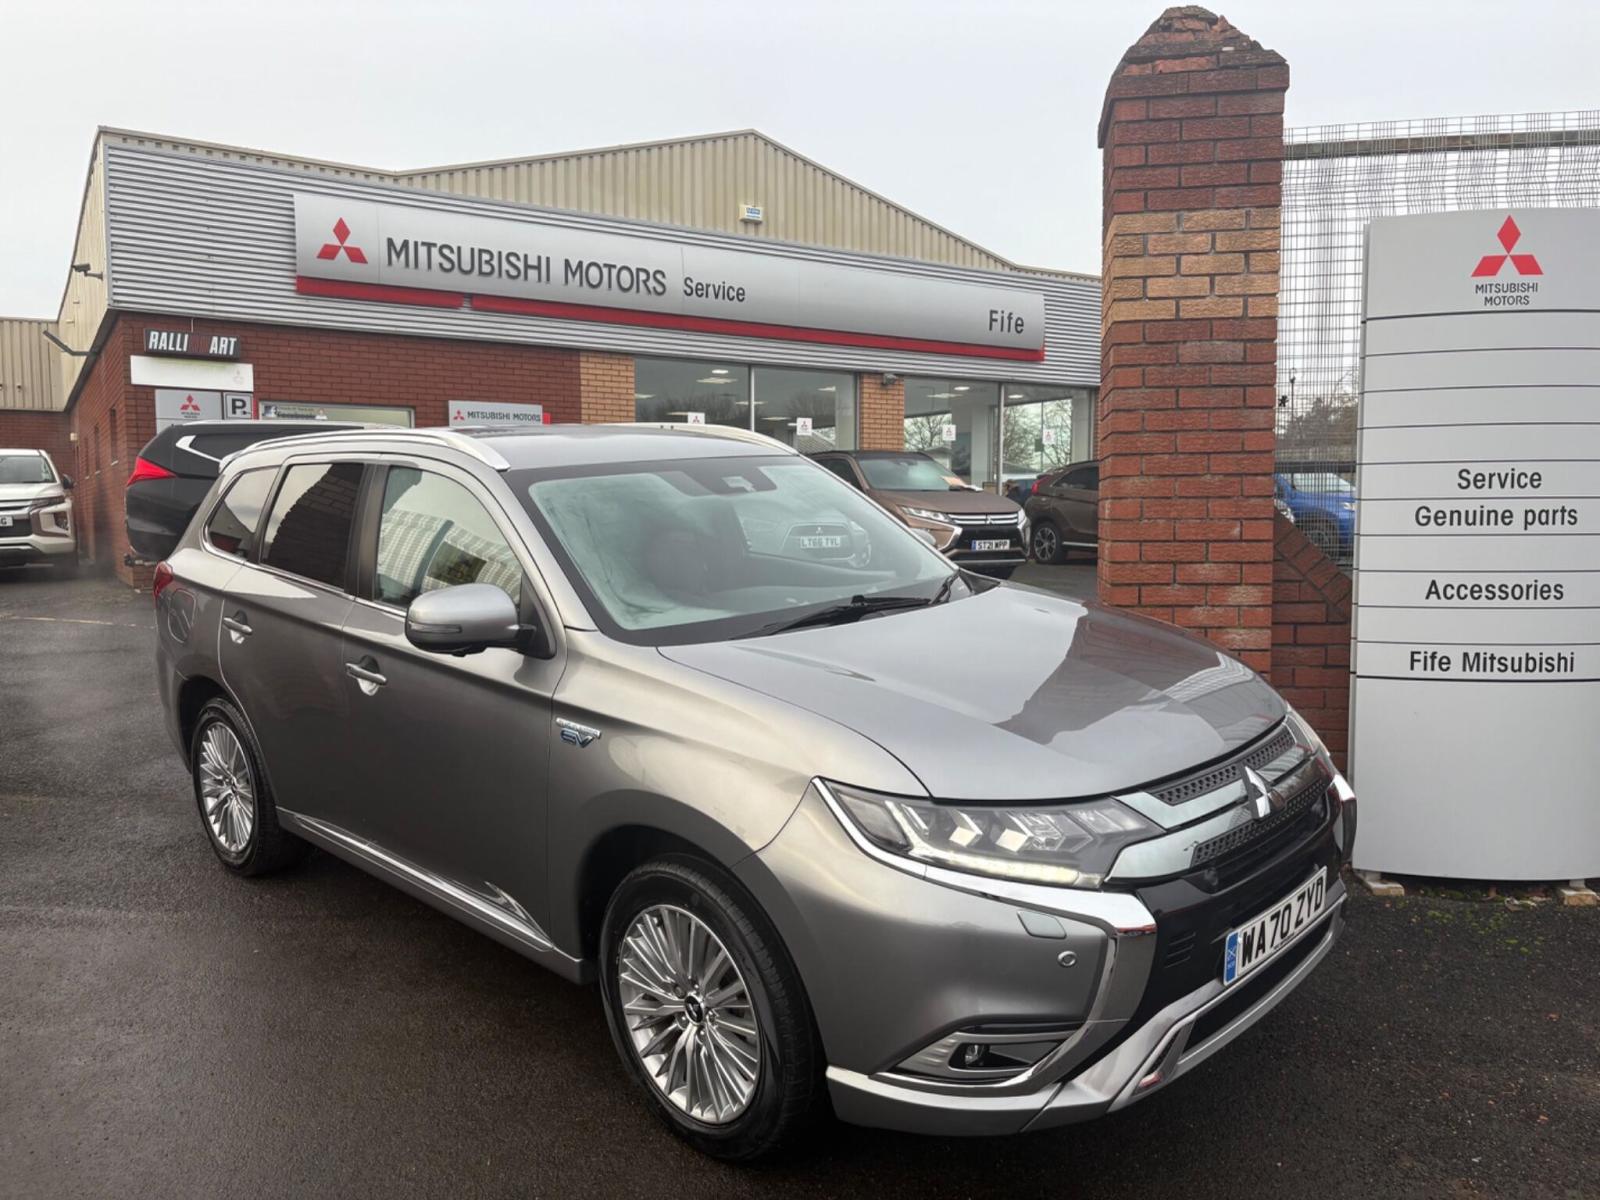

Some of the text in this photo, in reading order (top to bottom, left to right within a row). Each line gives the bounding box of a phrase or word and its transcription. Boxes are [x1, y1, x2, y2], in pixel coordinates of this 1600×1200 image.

[386, 237, 746, 302] MITSUBISHI MOTORS Service
[1475, 282, 1538, 294] MITSUBISHI
[1484, 295, 1530, 306] MOTORS
[989, 309, 1024, 334] Fife
[148, 330, 238, 355] RALLI ART
[467, 411, 541, 422] MITSUBISHI MOTORS
[1457, 468, 1542, 490] Service
[1415, 505, 1578, 531] Genuine parts
[1425, 579, 1564, 600] Accessories
[1410, 651, 1575, 673] Fife Mitsubishi
[1241, 875, 1324, 968] WA70 ZYD
